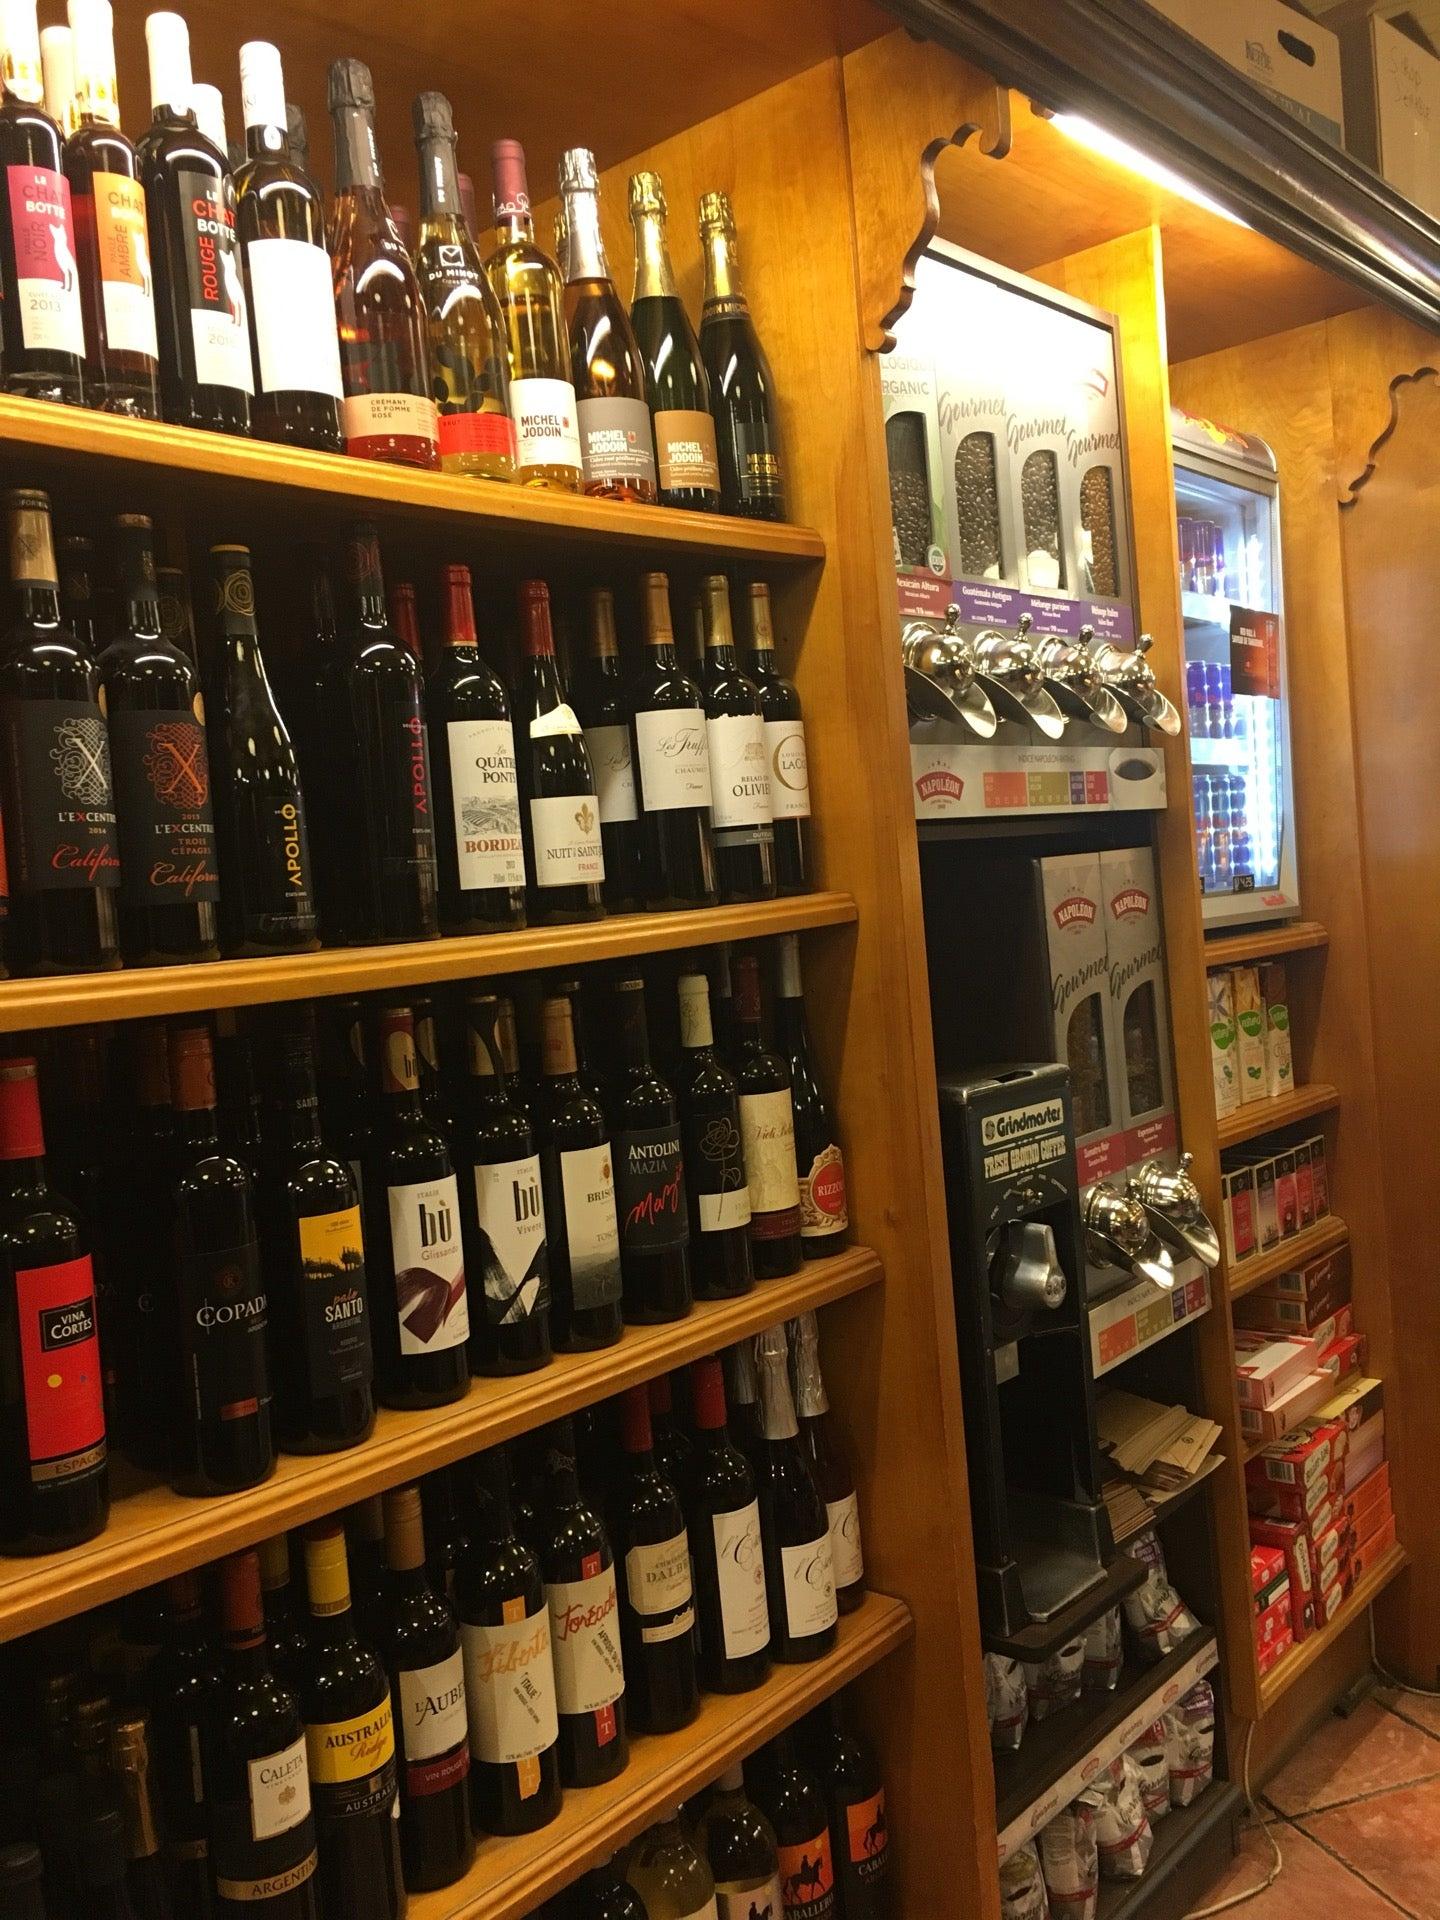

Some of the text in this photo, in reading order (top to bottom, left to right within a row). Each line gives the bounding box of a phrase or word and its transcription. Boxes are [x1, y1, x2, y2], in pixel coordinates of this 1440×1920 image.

[192, 199, 236, 227] CHAT
[199, 236, 220, 301] ROUGE
[429, 271, 443, 281] DU
[880, 380, 930, 396] RGANIC
[521, 415, 561, 428] MICHEL
[522, 426, 562, 438] JODOIN
[588, 430, 627, 443] MICHEL
[589, 441, 629, 455] JODOIN
[667, 442, 703, 453] MICHEL
[669, 452, 704, 464] JODOIN
[921, 776, 960, 797] NAPOLÉON
[1114, 892, 1149, 914] NAPOLÉON
[1058, 900, 1094, 924] NAPOLÉON
[997, 1106, 1061, 1137] Grindmaster
[628, 1139, 680, 1160] ANTOLINI
[984, 1134, 1067, 1178] FRESH GROUND COFFEE
[630, 1159, 668, 1175] MAZIA
[421, 1246, 459, 1262] Glissando
[325, 1296, 363, 1323] SANTO
[260, 1755, 304, 1786] CALETA
[425, 1770, 438, 1782] VIN
